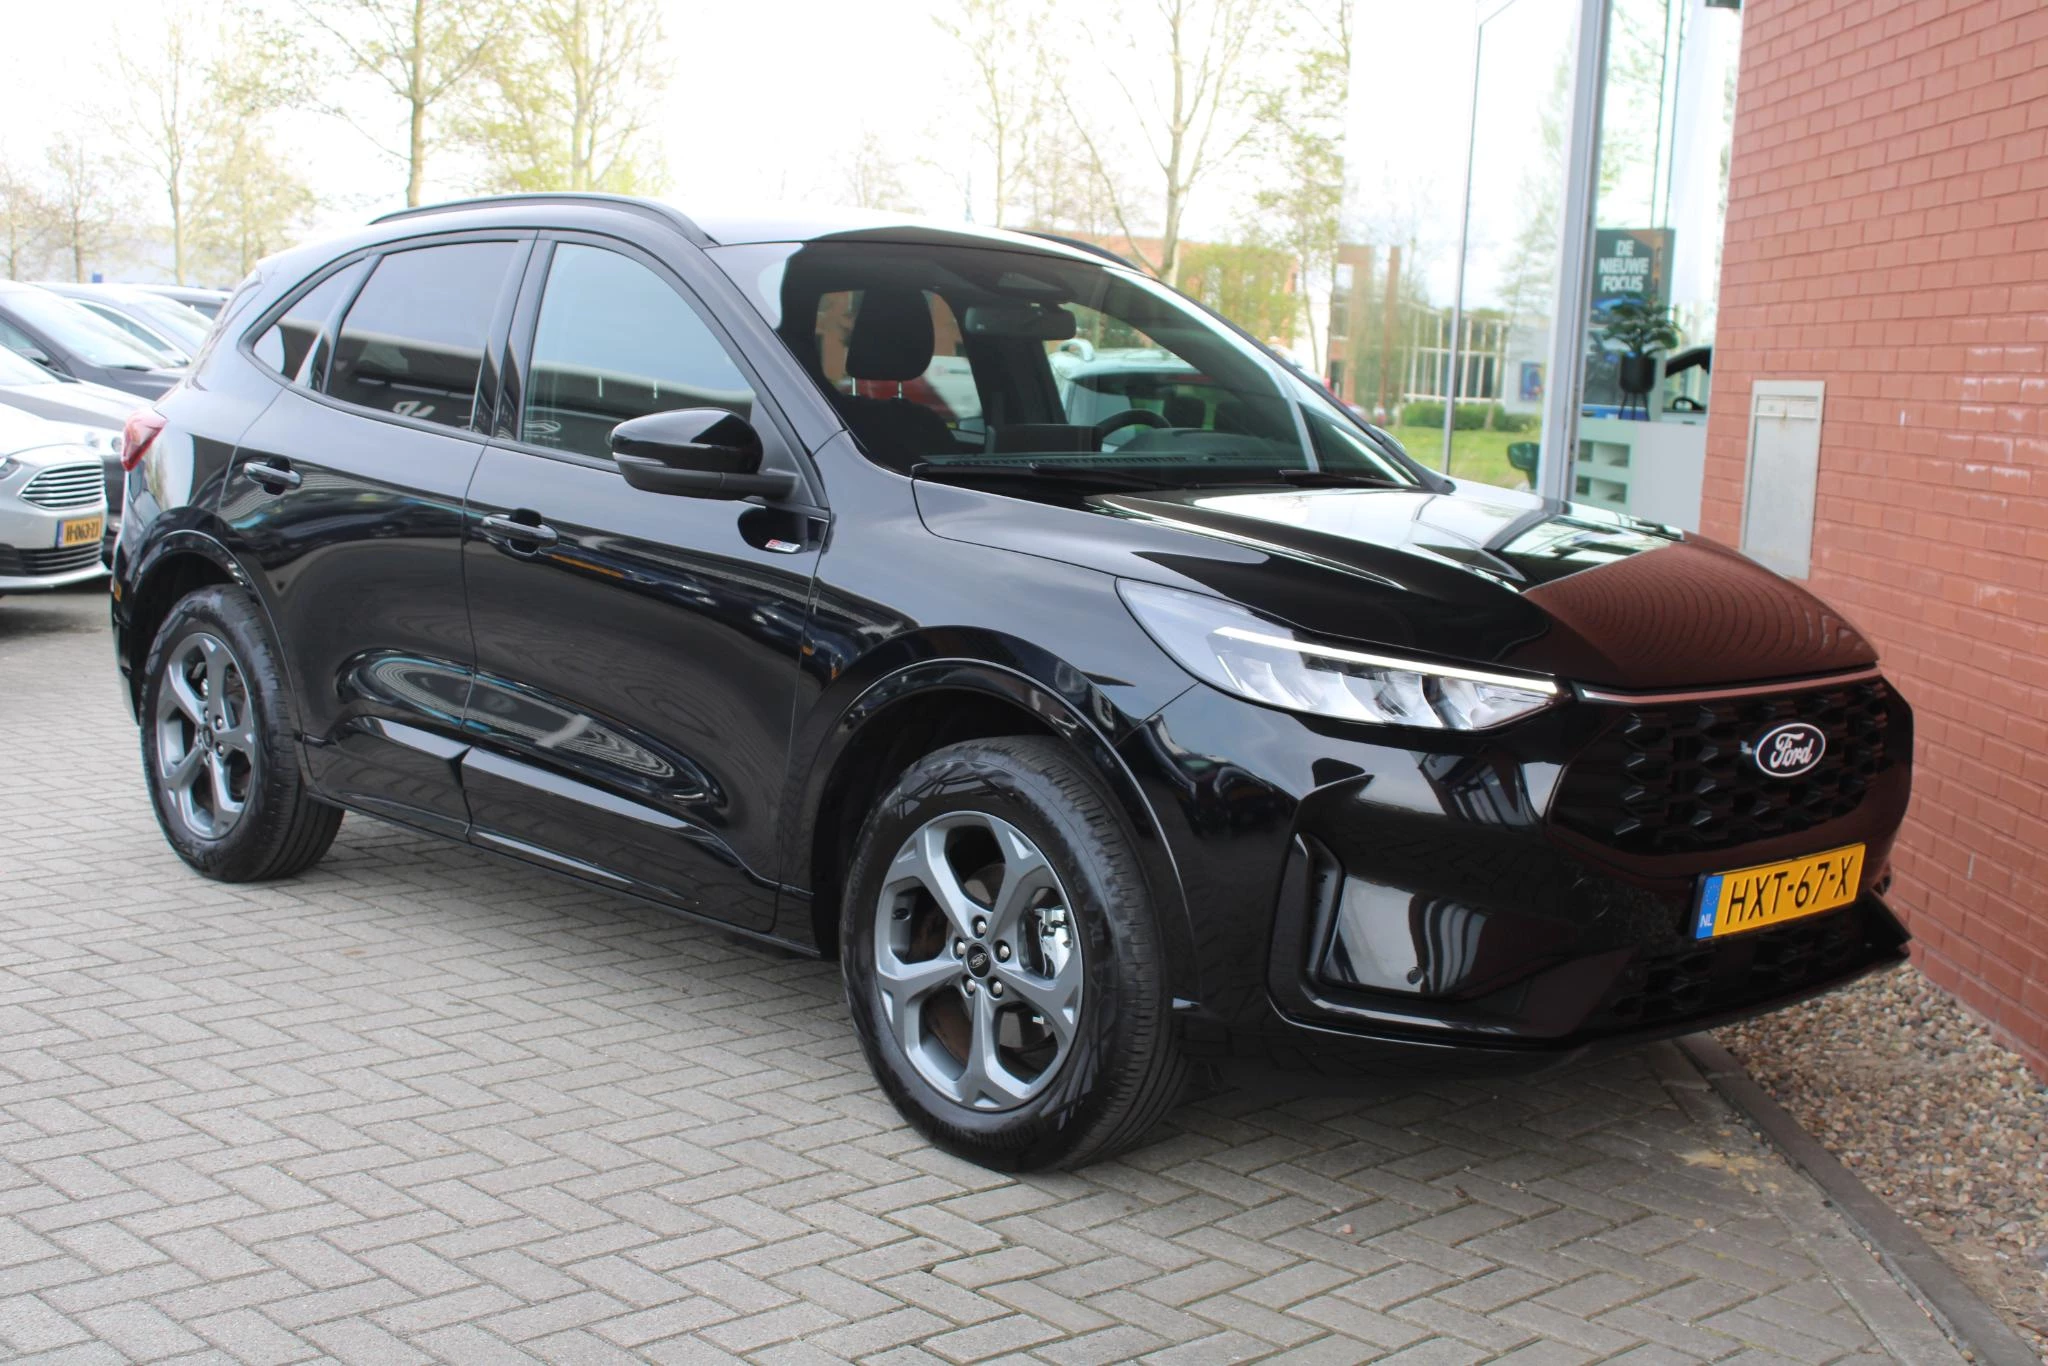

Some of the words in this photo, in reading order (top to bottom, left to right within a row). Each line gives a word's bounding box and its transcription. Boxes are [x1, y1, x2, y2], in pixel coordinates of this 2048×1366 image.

[1616, 240, 1634, 256] DE
[1598, 257, 1649, 274] NIEUWE
[1601, 275, 1643, 292] FOCUS
[1769, 732, 1814, 768] Ford
[1726, 855, 1854, 925] HXT-67-X
[1699, 914, 1713, 928] NL
